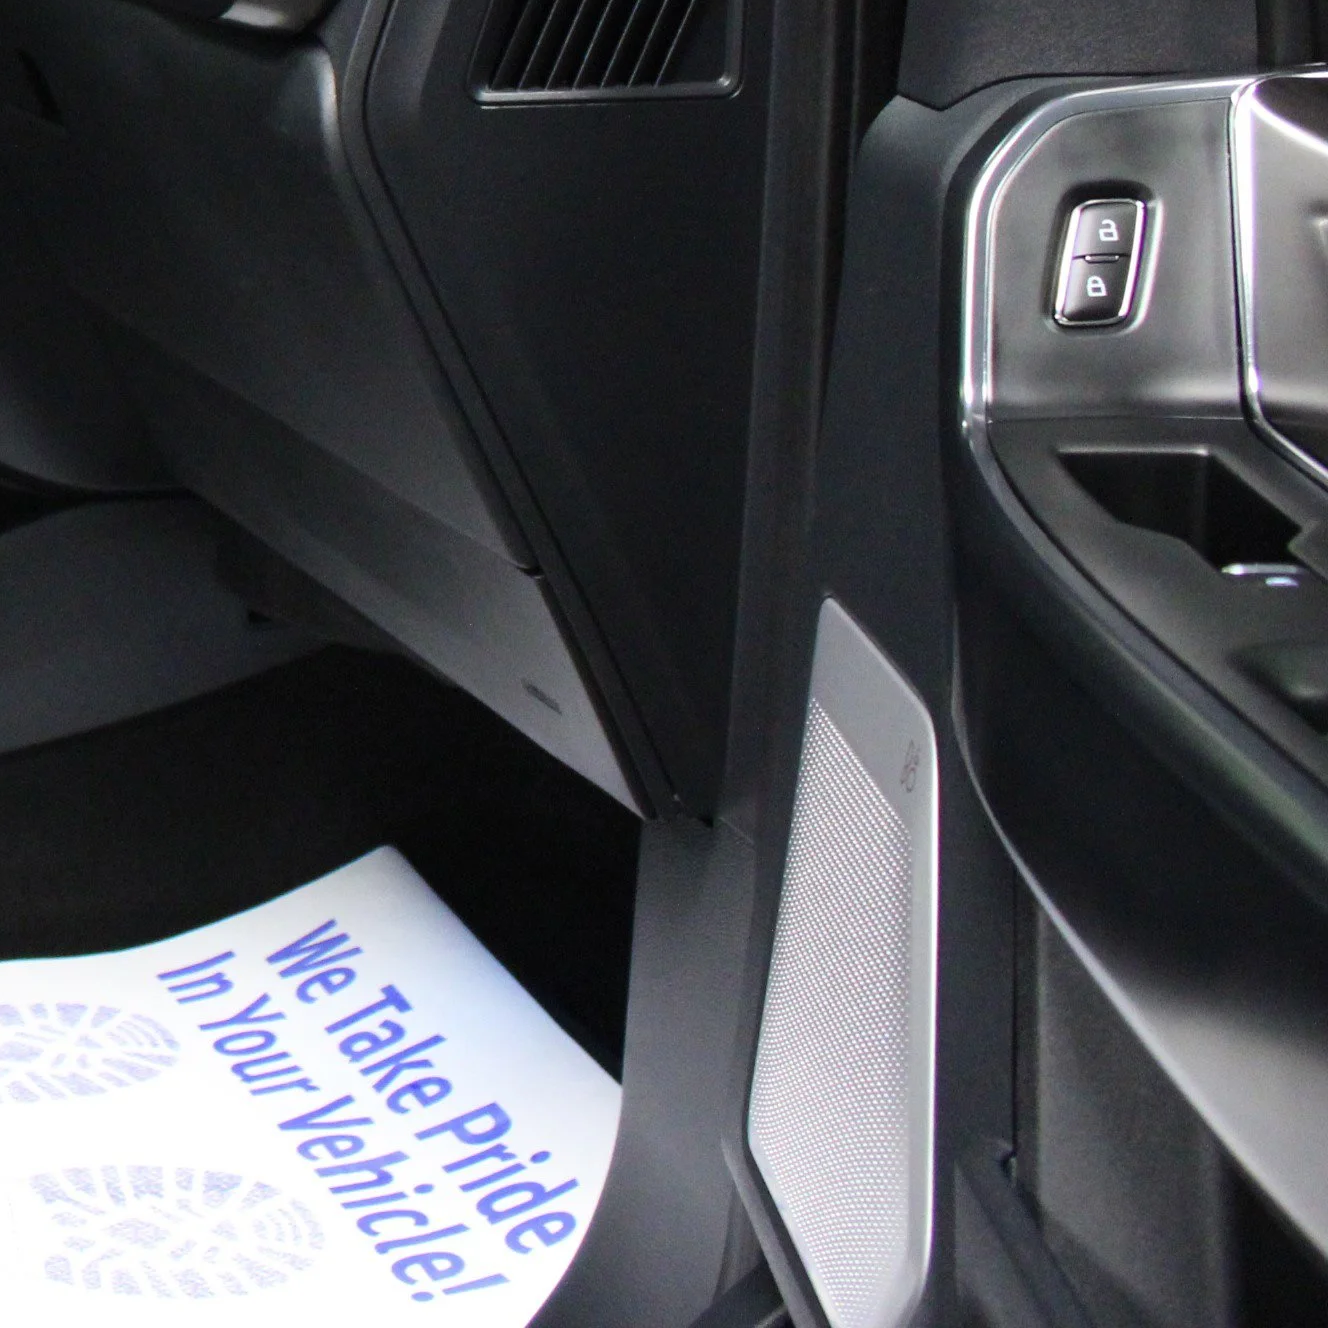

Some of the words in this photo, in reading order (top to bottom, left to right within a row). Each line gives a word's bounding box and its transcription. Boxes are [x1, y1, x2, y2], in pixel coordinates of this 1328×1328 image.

[156, 950, 235, 1004] In
[198, 993, 320, 1096] Your
[277, 1094, 510, 1302] Vehicle!
[266, 918, 363, 1004] We
[325, 984, 453, 1114] Take
[414, 1102, 579, 1254] Pride
